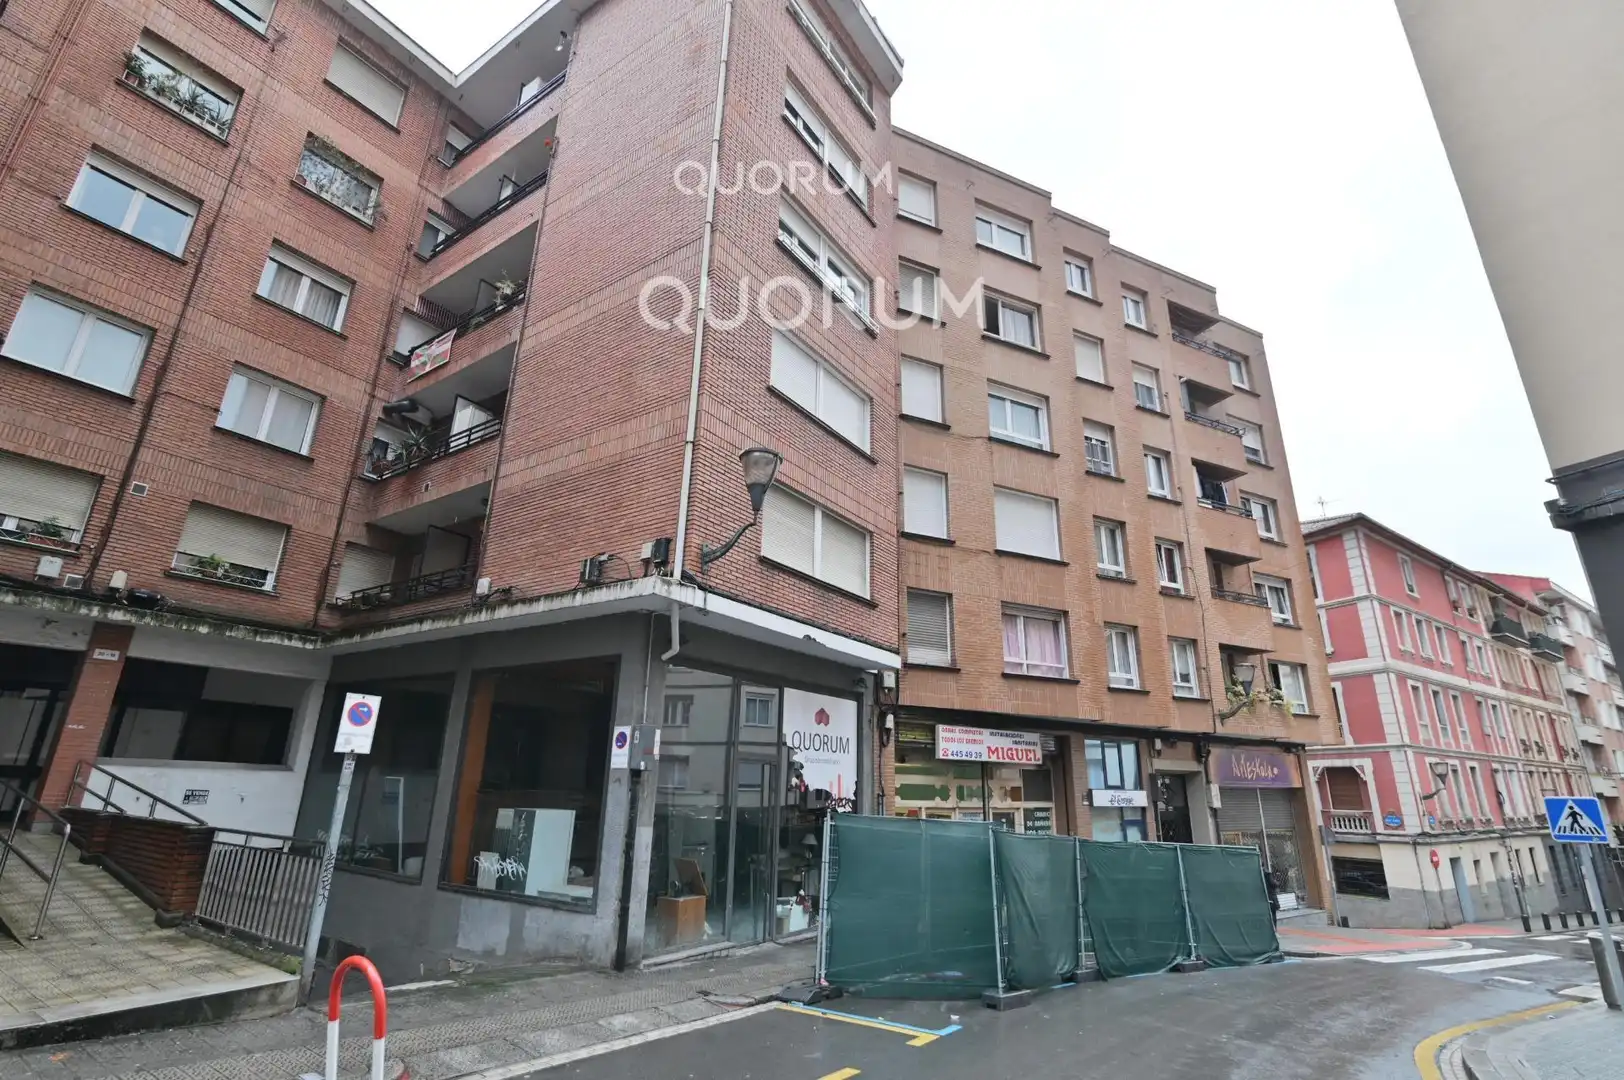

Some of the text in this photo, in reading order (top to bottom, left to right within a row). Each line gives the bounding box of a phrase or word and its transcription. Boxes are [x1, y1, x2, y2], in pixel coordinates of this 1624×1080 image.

[791, 730, 850, 755] QUORUM
[950, 750, 983, 759] 445 49 39
[986, 746, 1041, 762] MIGUEL
